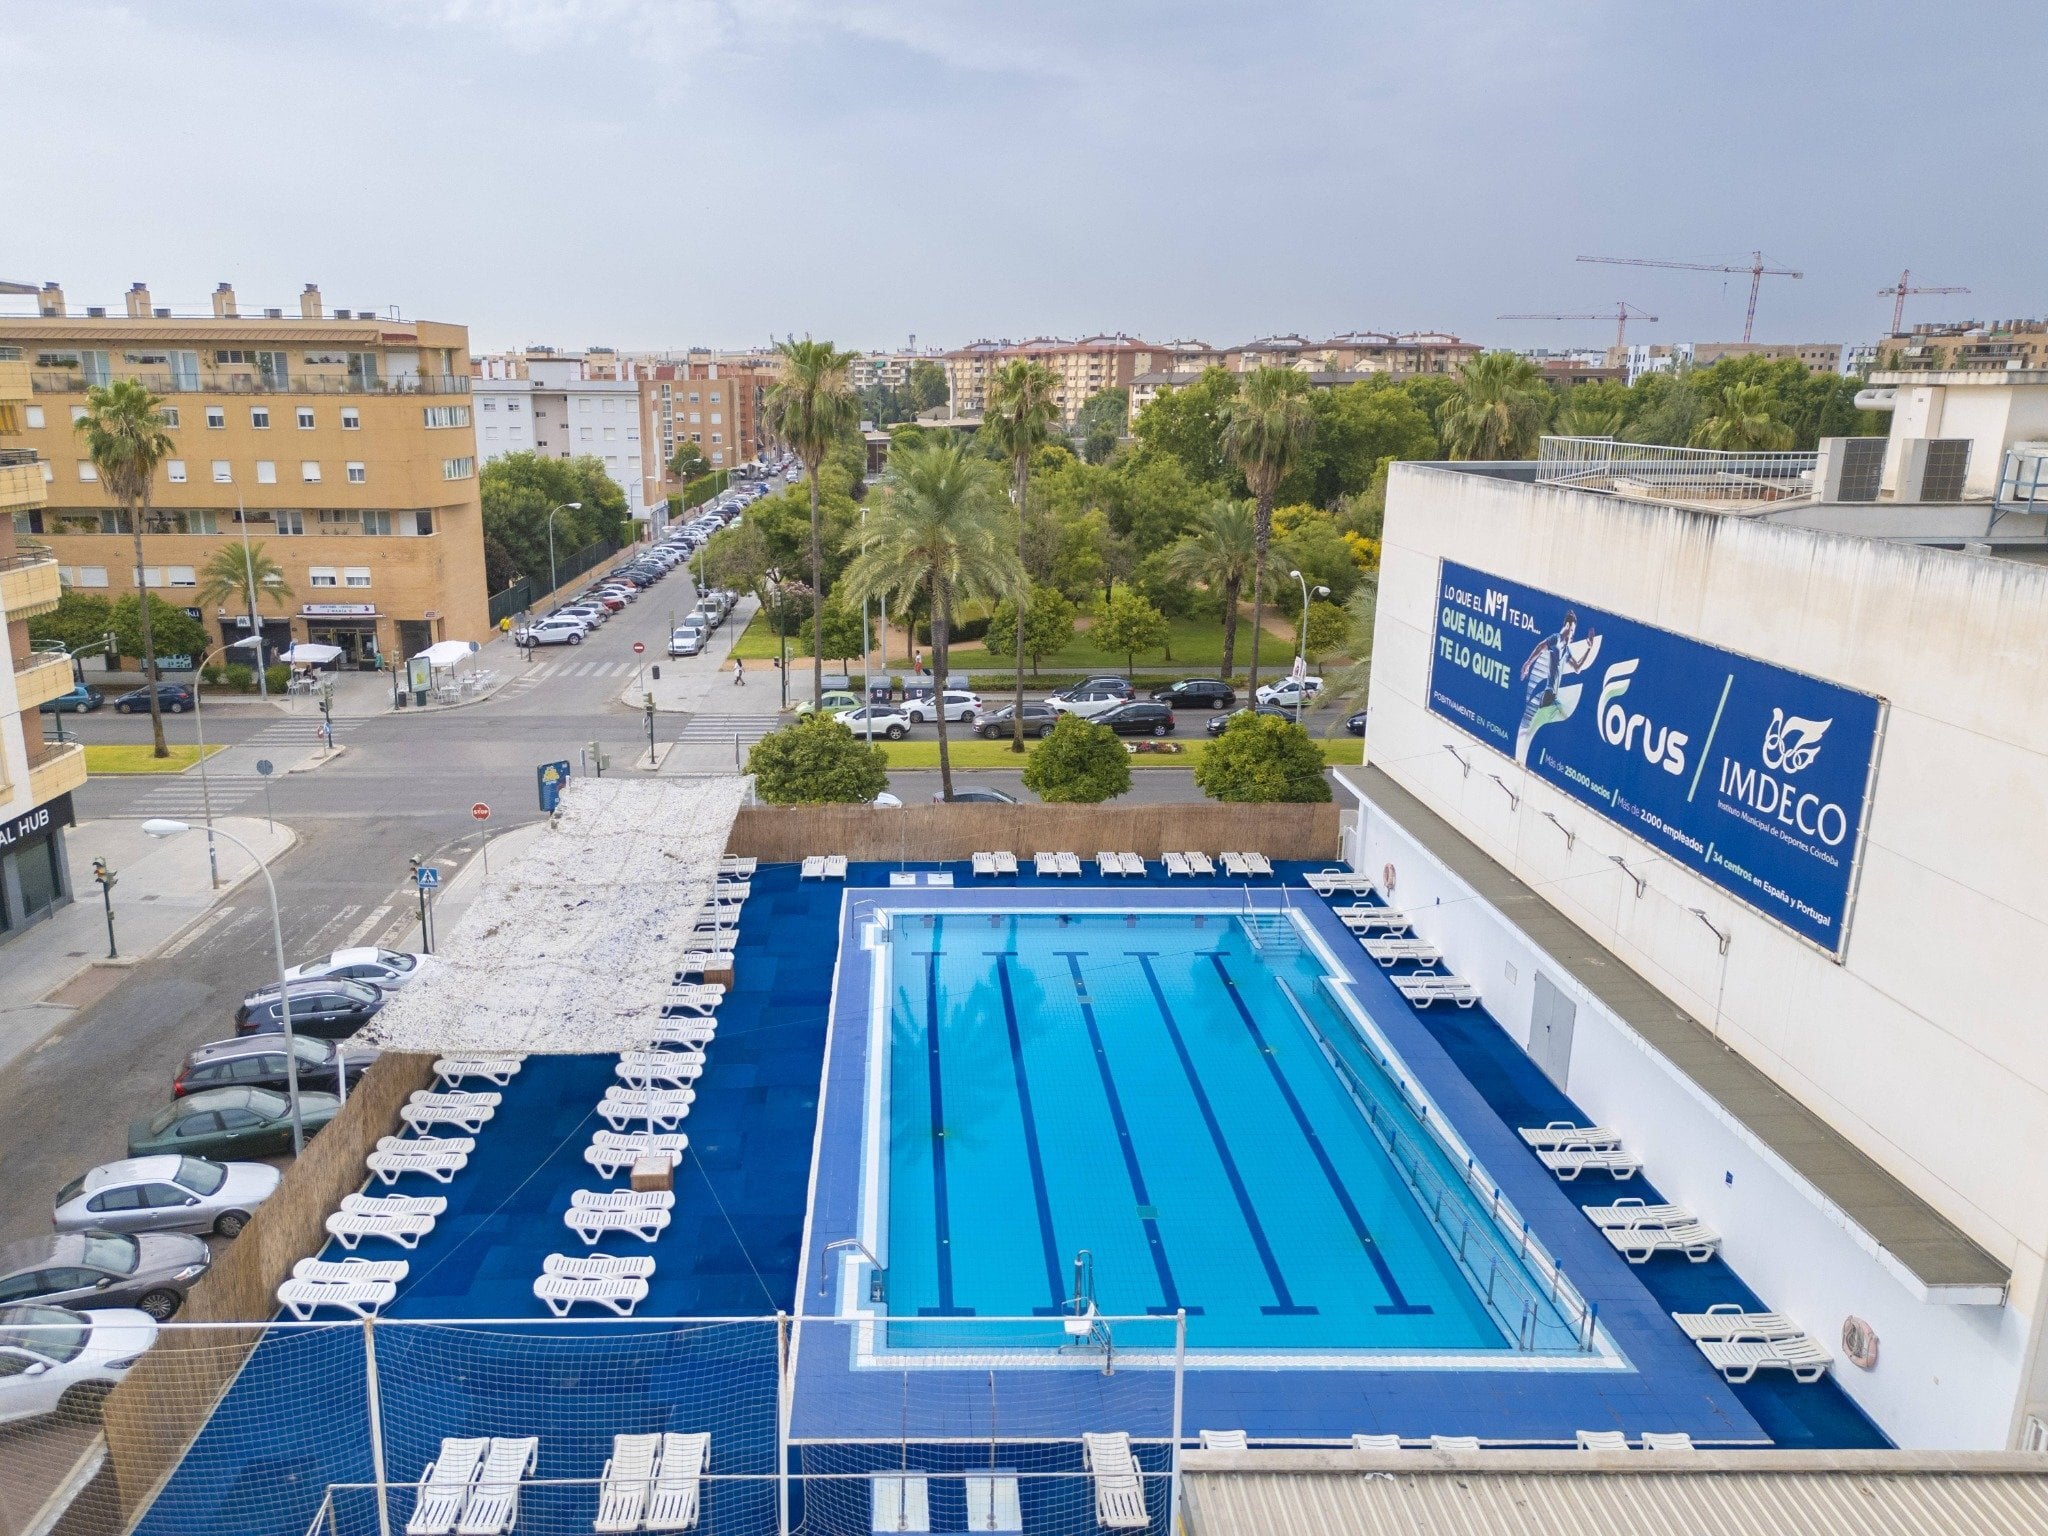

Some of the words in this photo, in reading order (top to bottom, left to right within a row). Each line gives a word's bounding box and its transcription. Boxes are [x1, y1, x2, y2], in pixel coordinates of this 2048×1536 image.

[1442, 606, 1465, 635] QUE
[1467, 616, 1502, 652] NADA
[1444, 584, 1455, 601] LO
[1455, 589, 1472, 606] QUE
[1472, 595, 1483, 613] EL
[1509, 608, 1520, 627] TE
[1439, 635, 1453, 661] TE
[1454, 643, 1470, 669] LO
[1472, 652, 1511, 689] QUITE
[1476, 715, 1486, 727] EN
[1486, 721, 1510, 740] FORMA
[1556, 760, 1565, 773] de
[1564, 765, 1590, 788] 250.000
[1590, 780, 1611, 800] socios
[1719, 756, 1847, 846] IMDECO
[18, 808, 50, 837] HUB
[1630, 802, 1640, 817] de
[1640, 809, 1662, 829] 2.000
[1662, 824, 1704, 854] empleados
[1717, 799, 1741, 818] Instituto
[1741, 811, 1770, 833] Municipal
[1770, 826, 1779, 838] de
[1779, 830, 1809, 852] Deportes
[1809, 845, 1839, 868] Córdoba
[1713, 851, 1723, 865] 34
[1723, 859, 1753, 882] centros
[1753, 876, 1763, 889] en
[1763, 880, 1790, 904] España
[1790, 896, 1797, 908] y
[1796, 899, 1832, 927] Portugal
